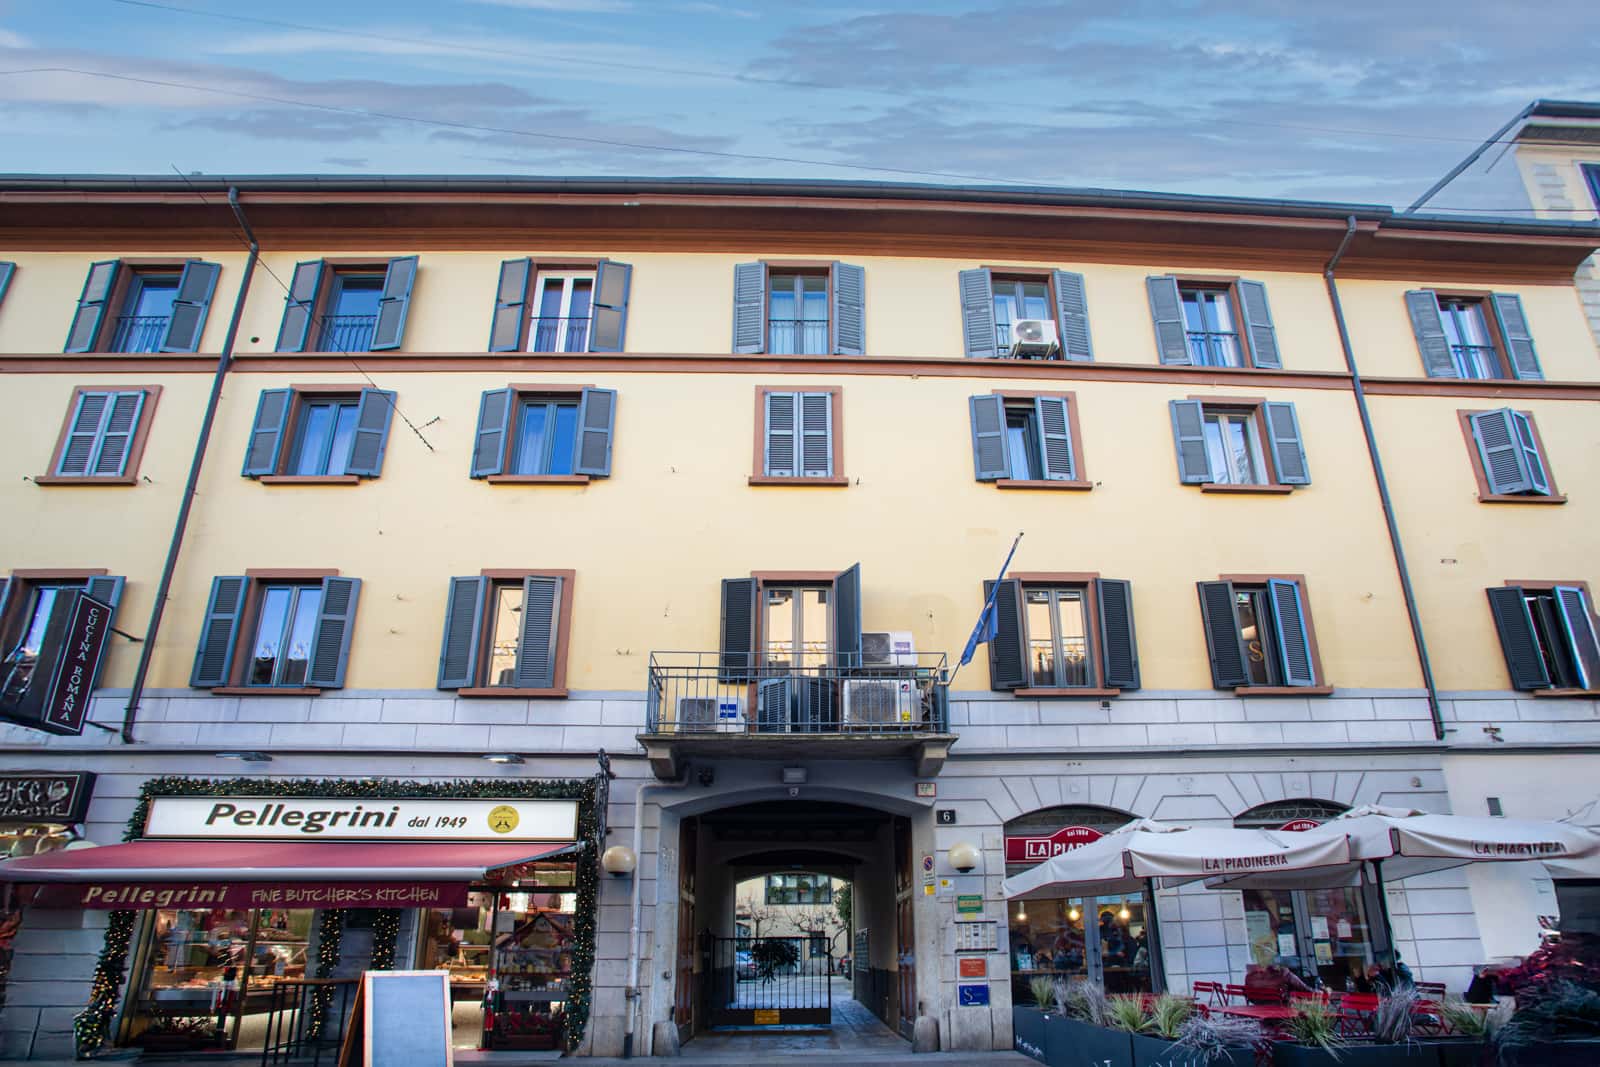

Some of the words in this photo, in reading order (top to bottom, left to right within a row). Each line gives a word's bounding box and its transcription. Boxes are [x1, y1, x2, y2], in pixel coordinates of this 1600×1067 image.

[77, 608, 99, 661] CUCINA
[60, 666, 82, 721] ROMANA
[205, 803, 400, 833] Pellegrini
[407, 816, 429, 829] dal
[435, 816, 468, 829] 1949
[943, 811, 951, 822] 6
[1029, 843, 1047, 856] LA
[1205, 858, 1221, 870] LA
[1225, 855, 1289, 869] PIADINERIA
[82, 886, 229, 907] Pellegrini
[252, 889, 281, 902] FINE
[286, 888, 373, 902] BUTCHER'S
[376, 887, 440, 902] KITCHEN
